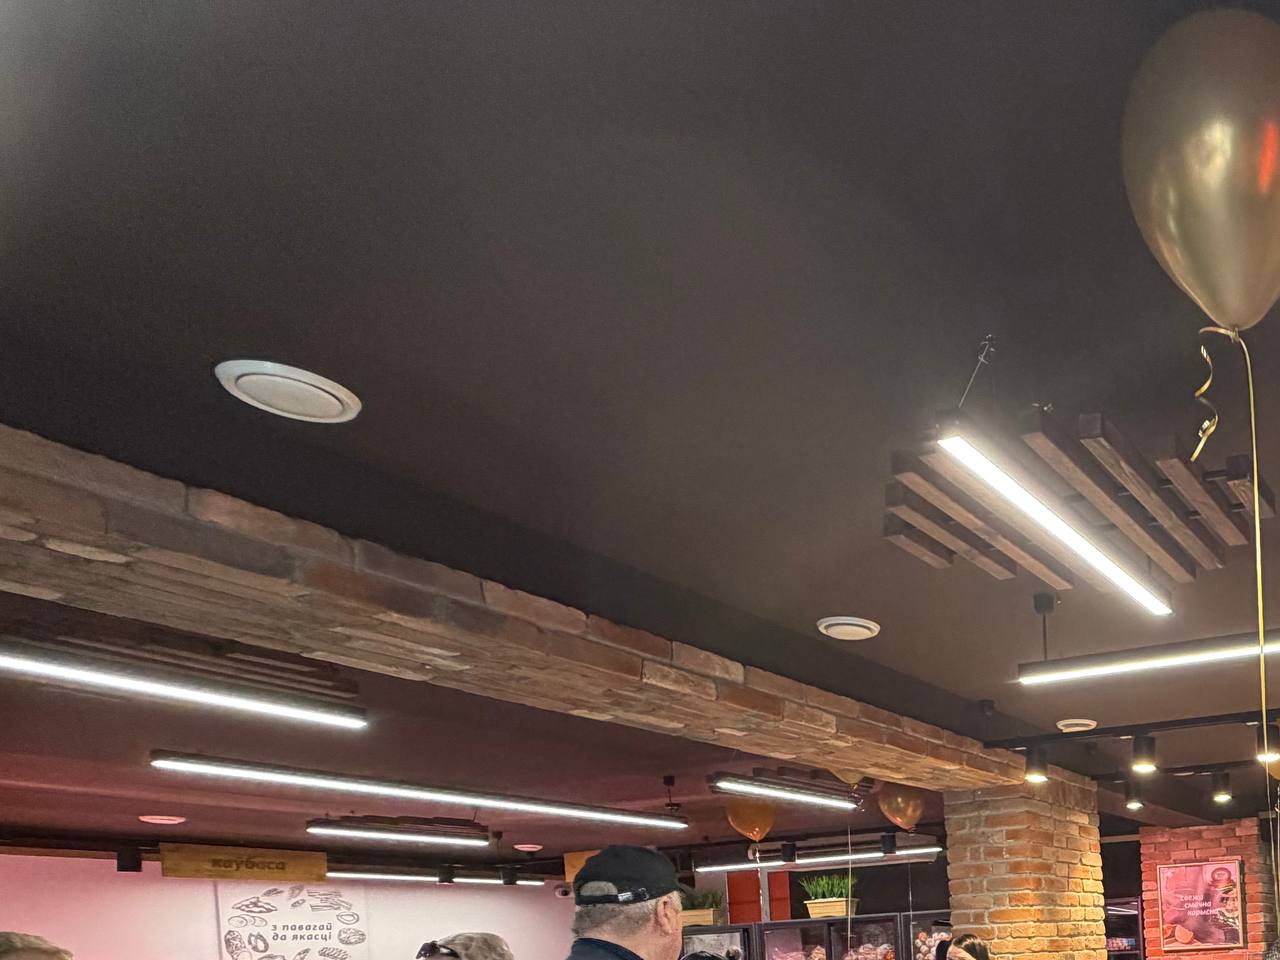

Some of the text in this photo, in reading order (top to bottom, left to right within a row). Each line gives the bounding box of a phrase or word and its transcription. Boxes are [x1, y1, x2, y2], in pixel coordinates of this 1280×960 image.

[211, 857, 286, 871] каўбаса
[282, 922, 333, 932] павагай
[272, 931, 333, 942] да якасці
